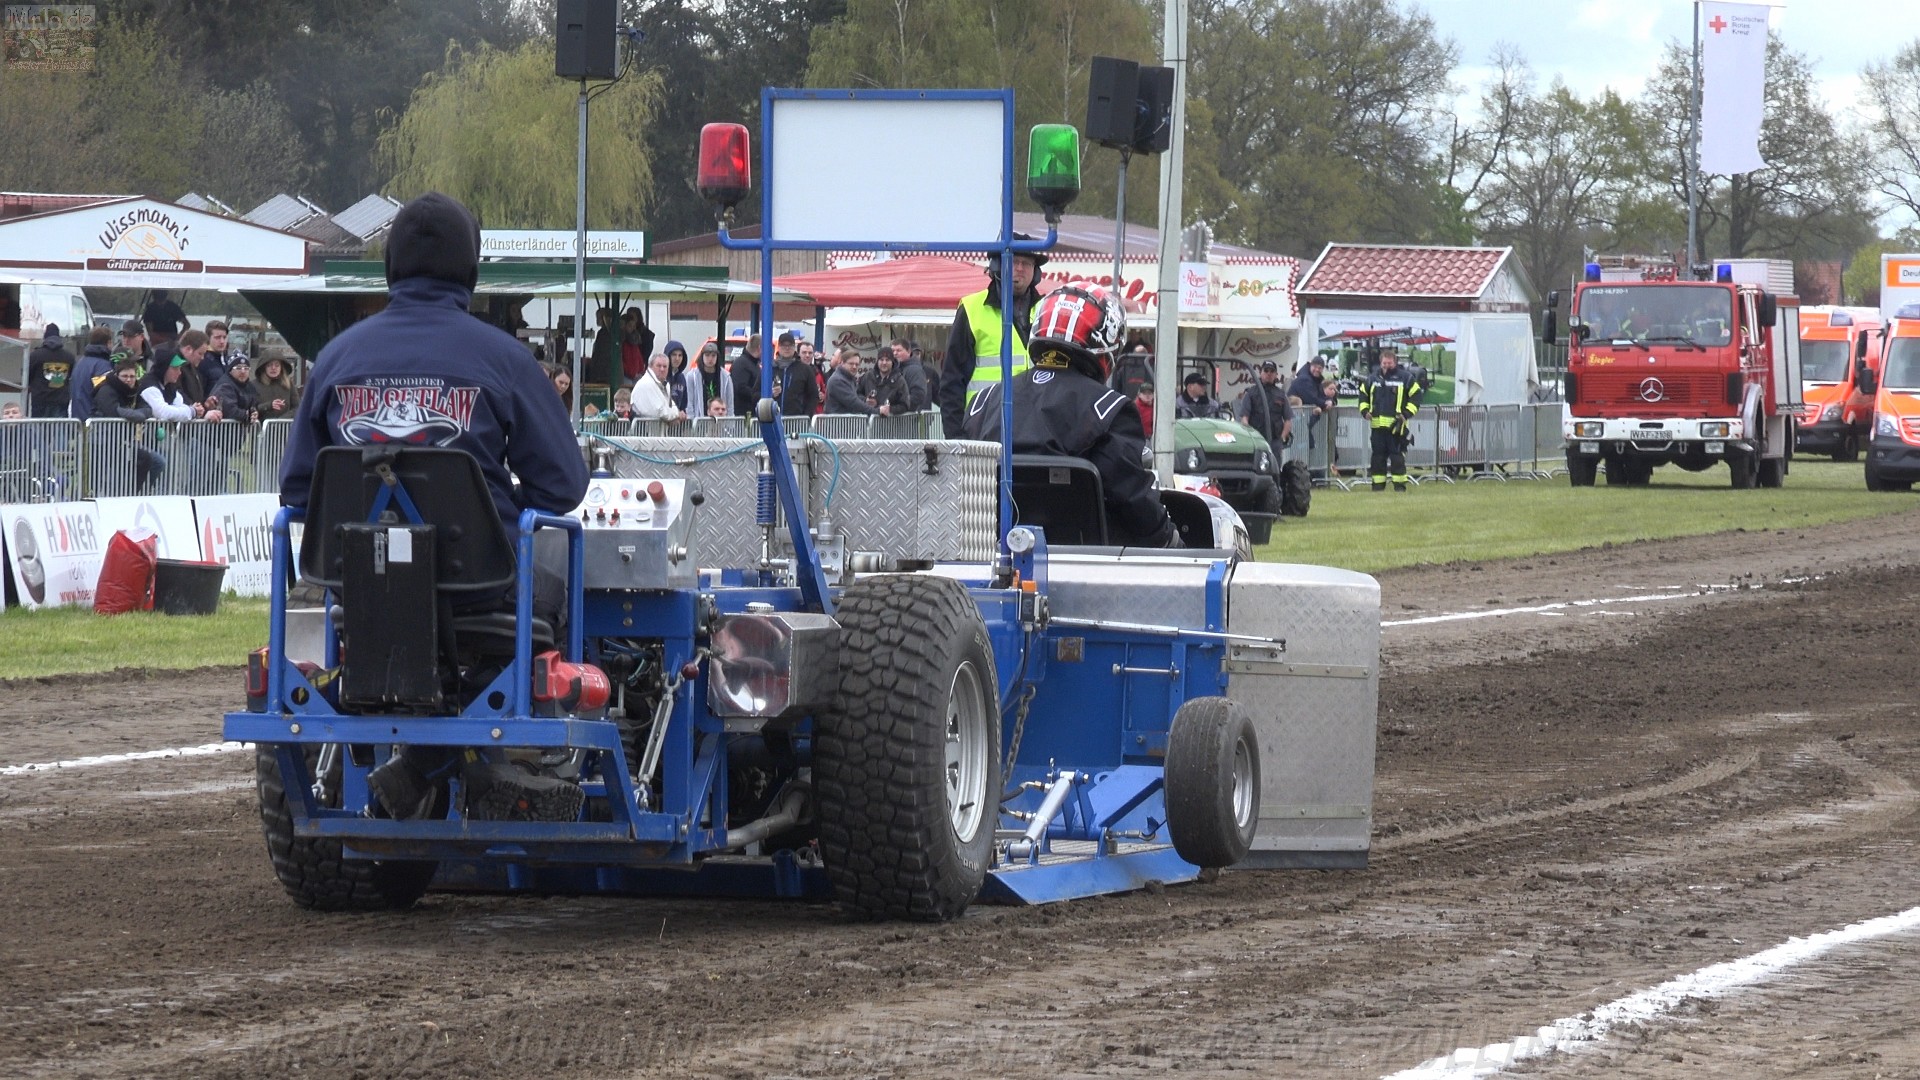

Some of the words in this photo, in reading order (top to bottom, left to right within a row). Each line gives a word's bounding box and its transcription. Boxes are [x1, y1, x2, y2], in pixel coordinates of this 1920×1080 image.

[99, 208, 189, 251] Wissmann's
[480, 237, 567, 251] Münsterländer
[107, 258, 184, 271] Grillspezialitäten
[1239, 279, 1264, 297] 60
[389, 378, 445, 387] MODIFIED
[335, 384, 381, 428] THE
[382, 386, 481, 432] OUTLAW
[223, 511, 274, 563] Ekruth
